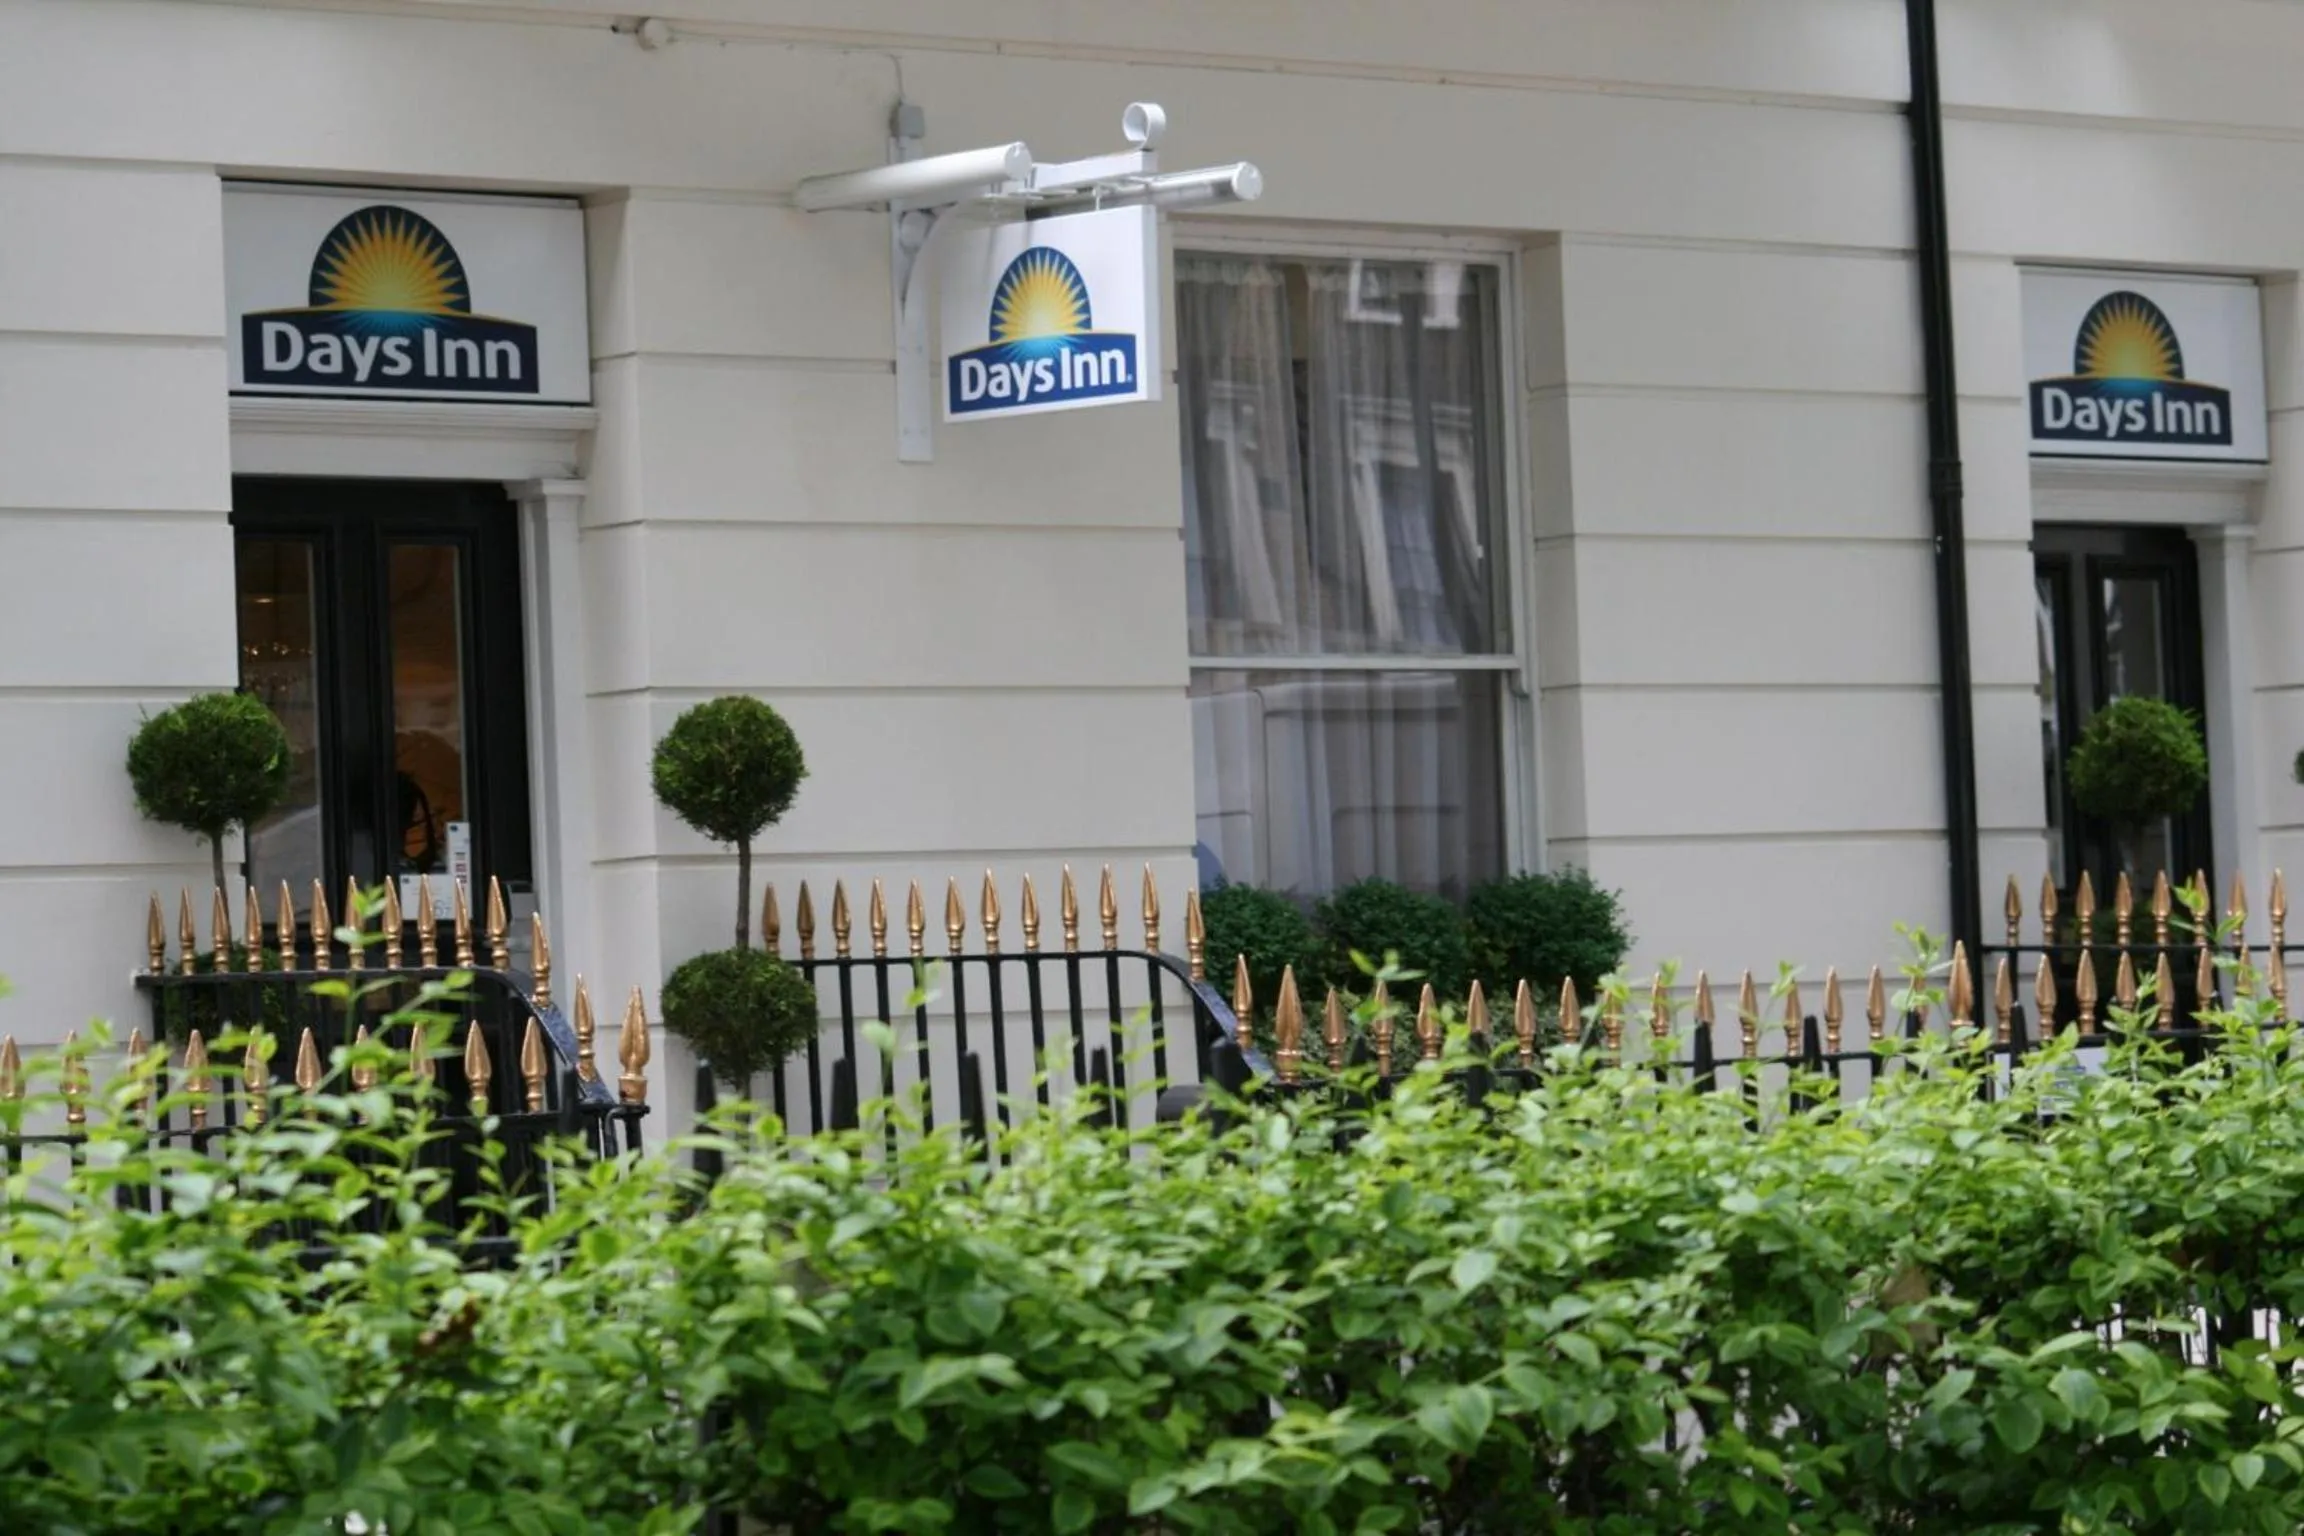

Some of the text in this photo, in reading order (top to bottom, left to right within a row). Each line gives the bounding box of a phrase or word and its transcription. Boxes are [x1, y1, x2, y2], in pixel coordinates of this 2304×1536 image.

[261, 321, 521, 382] Days Inn
[960, 346, 1125, 402] Days Inn
[2042, 387, 2221, 438] Days Inn
